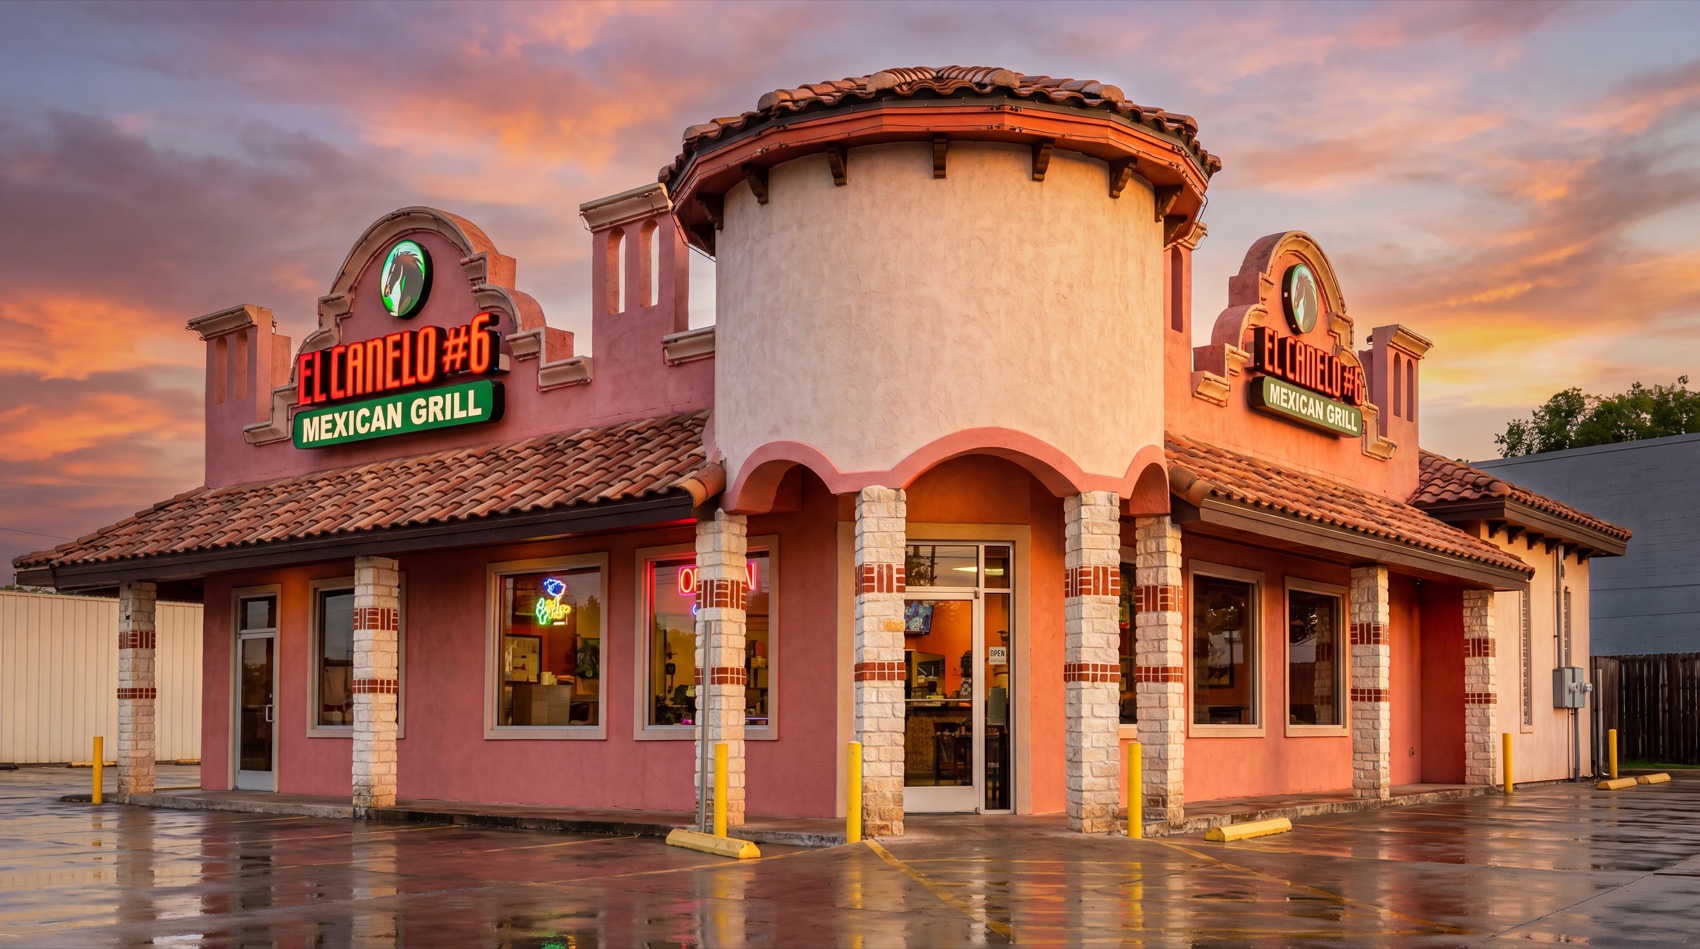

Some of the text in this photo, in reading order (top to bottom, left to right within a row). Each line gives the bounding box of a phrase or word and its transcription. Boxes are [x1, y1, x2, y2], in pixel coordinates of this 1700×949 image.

[298, 312, 491, 405] EL CANELO #6
[1265, 326, 1363, 406] EL CANELO #6
[302, 389, 482, 443] MEXICAN GRILL
[1269, 383, 1358, 432] MEXICAN GRILL
[680, 562, 755, 593] ON
[989, 649, 1005, 657] OPEN
